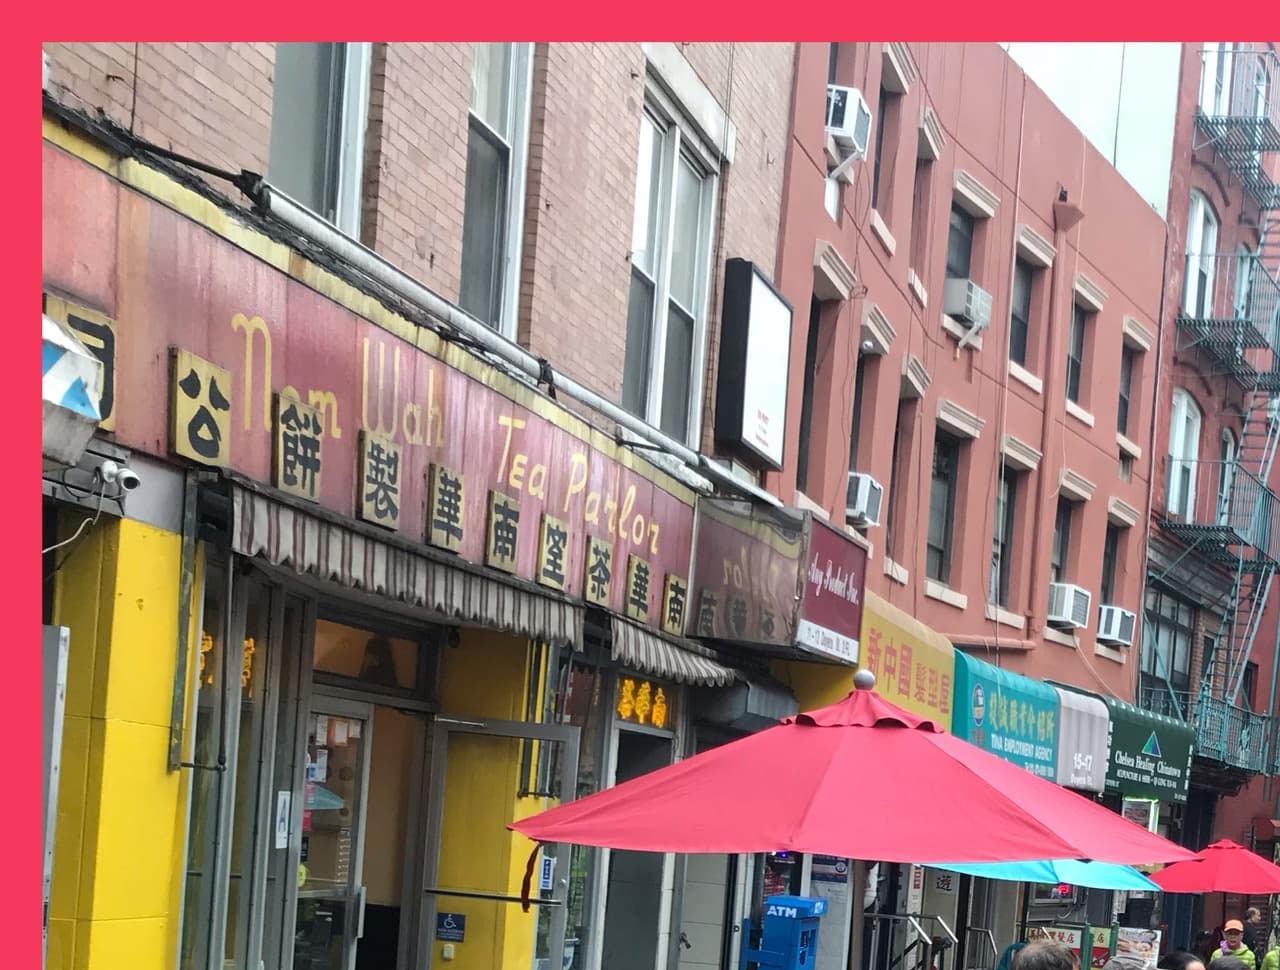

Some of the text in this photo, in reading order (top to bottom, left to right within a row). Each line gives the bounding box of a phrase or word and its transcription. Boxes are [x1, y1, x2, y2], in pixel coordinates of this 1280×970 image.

[362, 336, 445, 447] Wah
[497, 415, 547, 500] Tea
[562, 452, 660, 555] Parlor
[1004, 737, 1034, 758] EMPLOYMENT
[1035, 745, 1053, 761] AGENCY
[1073, 752, 1093, 772] 15-17
[1114, 750, 1182, 778] Chelsea Healing Chinatown
[767, 905, 797, 919] ATM
